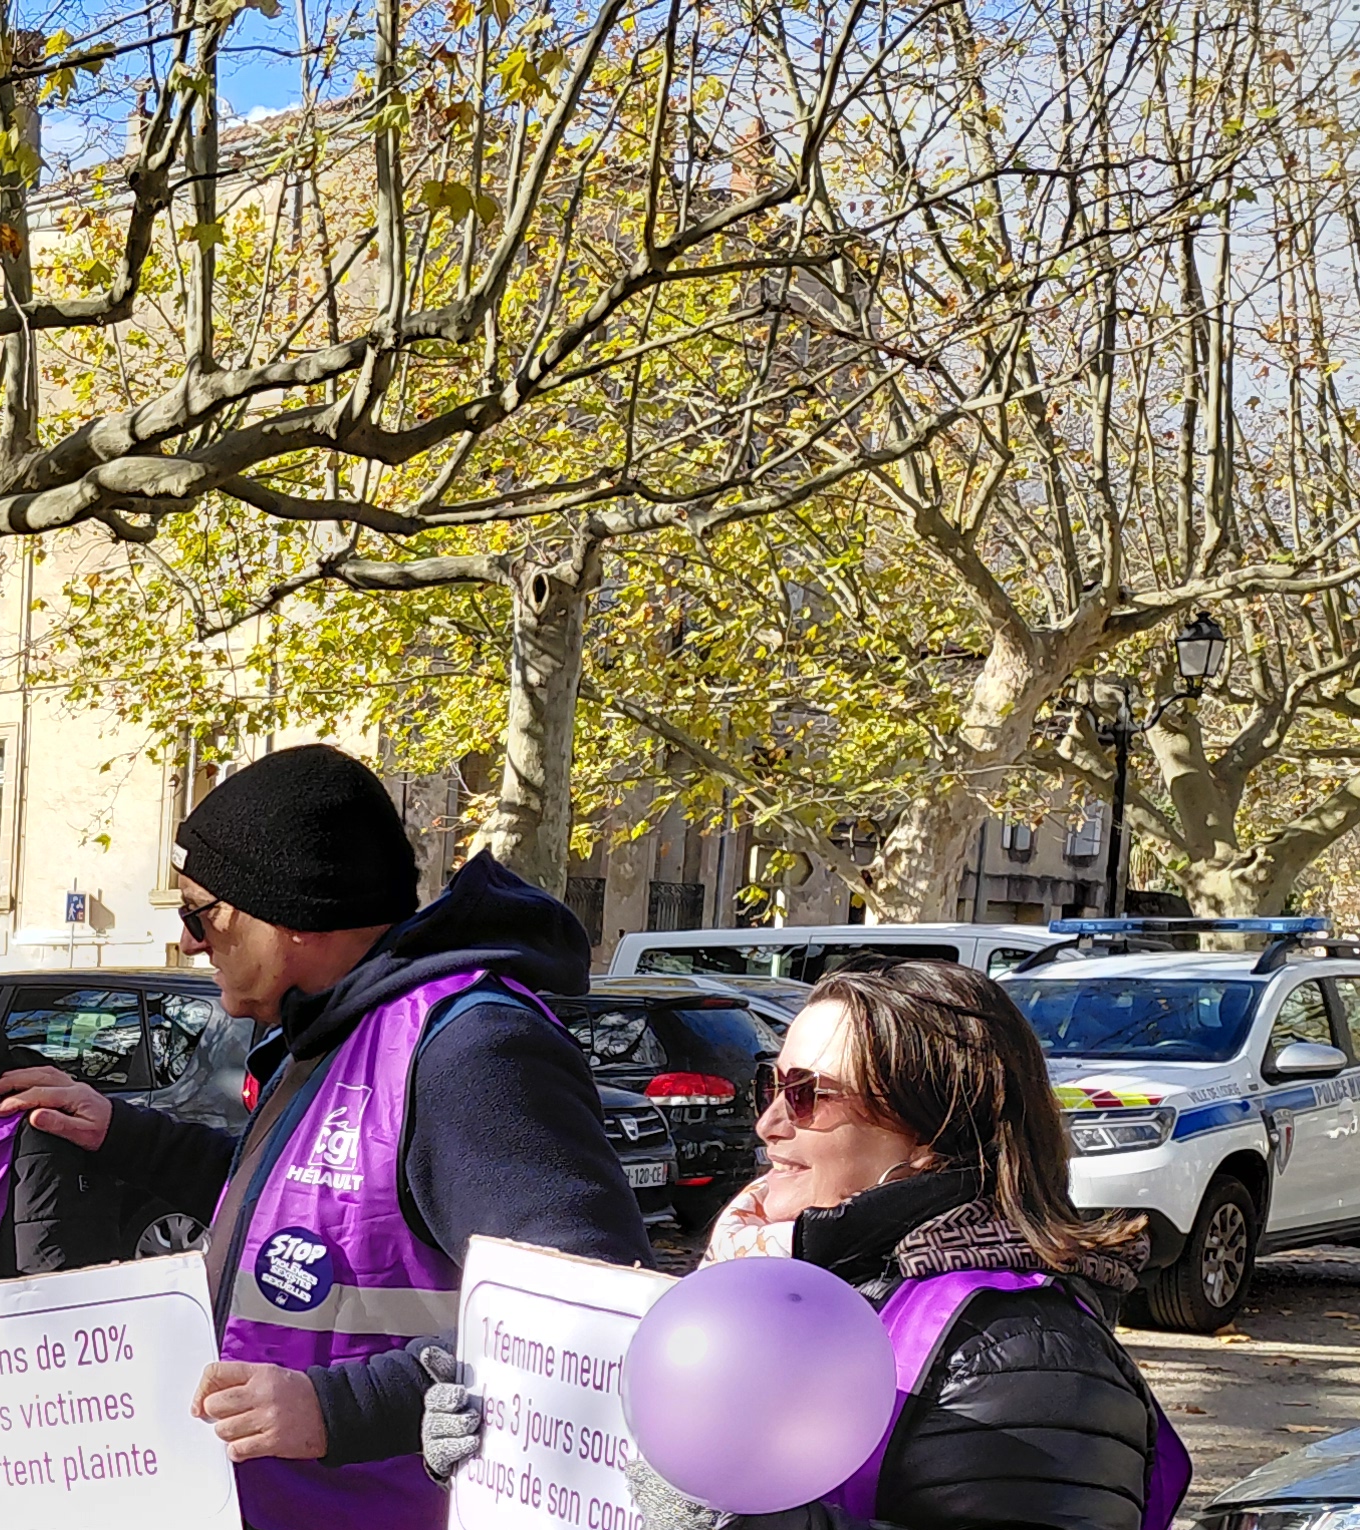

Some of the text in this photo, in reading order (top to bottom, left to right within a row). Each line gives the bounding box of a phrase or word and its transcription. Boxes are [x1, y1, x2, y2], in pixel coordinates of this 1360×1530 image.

[1314, 1079, 1349, 1106] POLICE
[315, 1126, 360, 1165] cgt
[264, 1234, 327, 1265] STOP
[36, 1334, 67, 1371] de
[74, 1323, 134, 1367] 20%
[482, 1316, 624, 1397] 1 femme meurt
[20, 1390, 135, 1430] victimes
[510, 1393, 521, 1436] 3
[523, 1398, 573, 1455] jours
[579, 1426, 630, 1472] sous
[63, 1443, 158, 1492] plainte
[467, 1450, 515, 1505] coups
[520, 1462, 542, 1509] de
[547, 1482, 581, 1526] son
